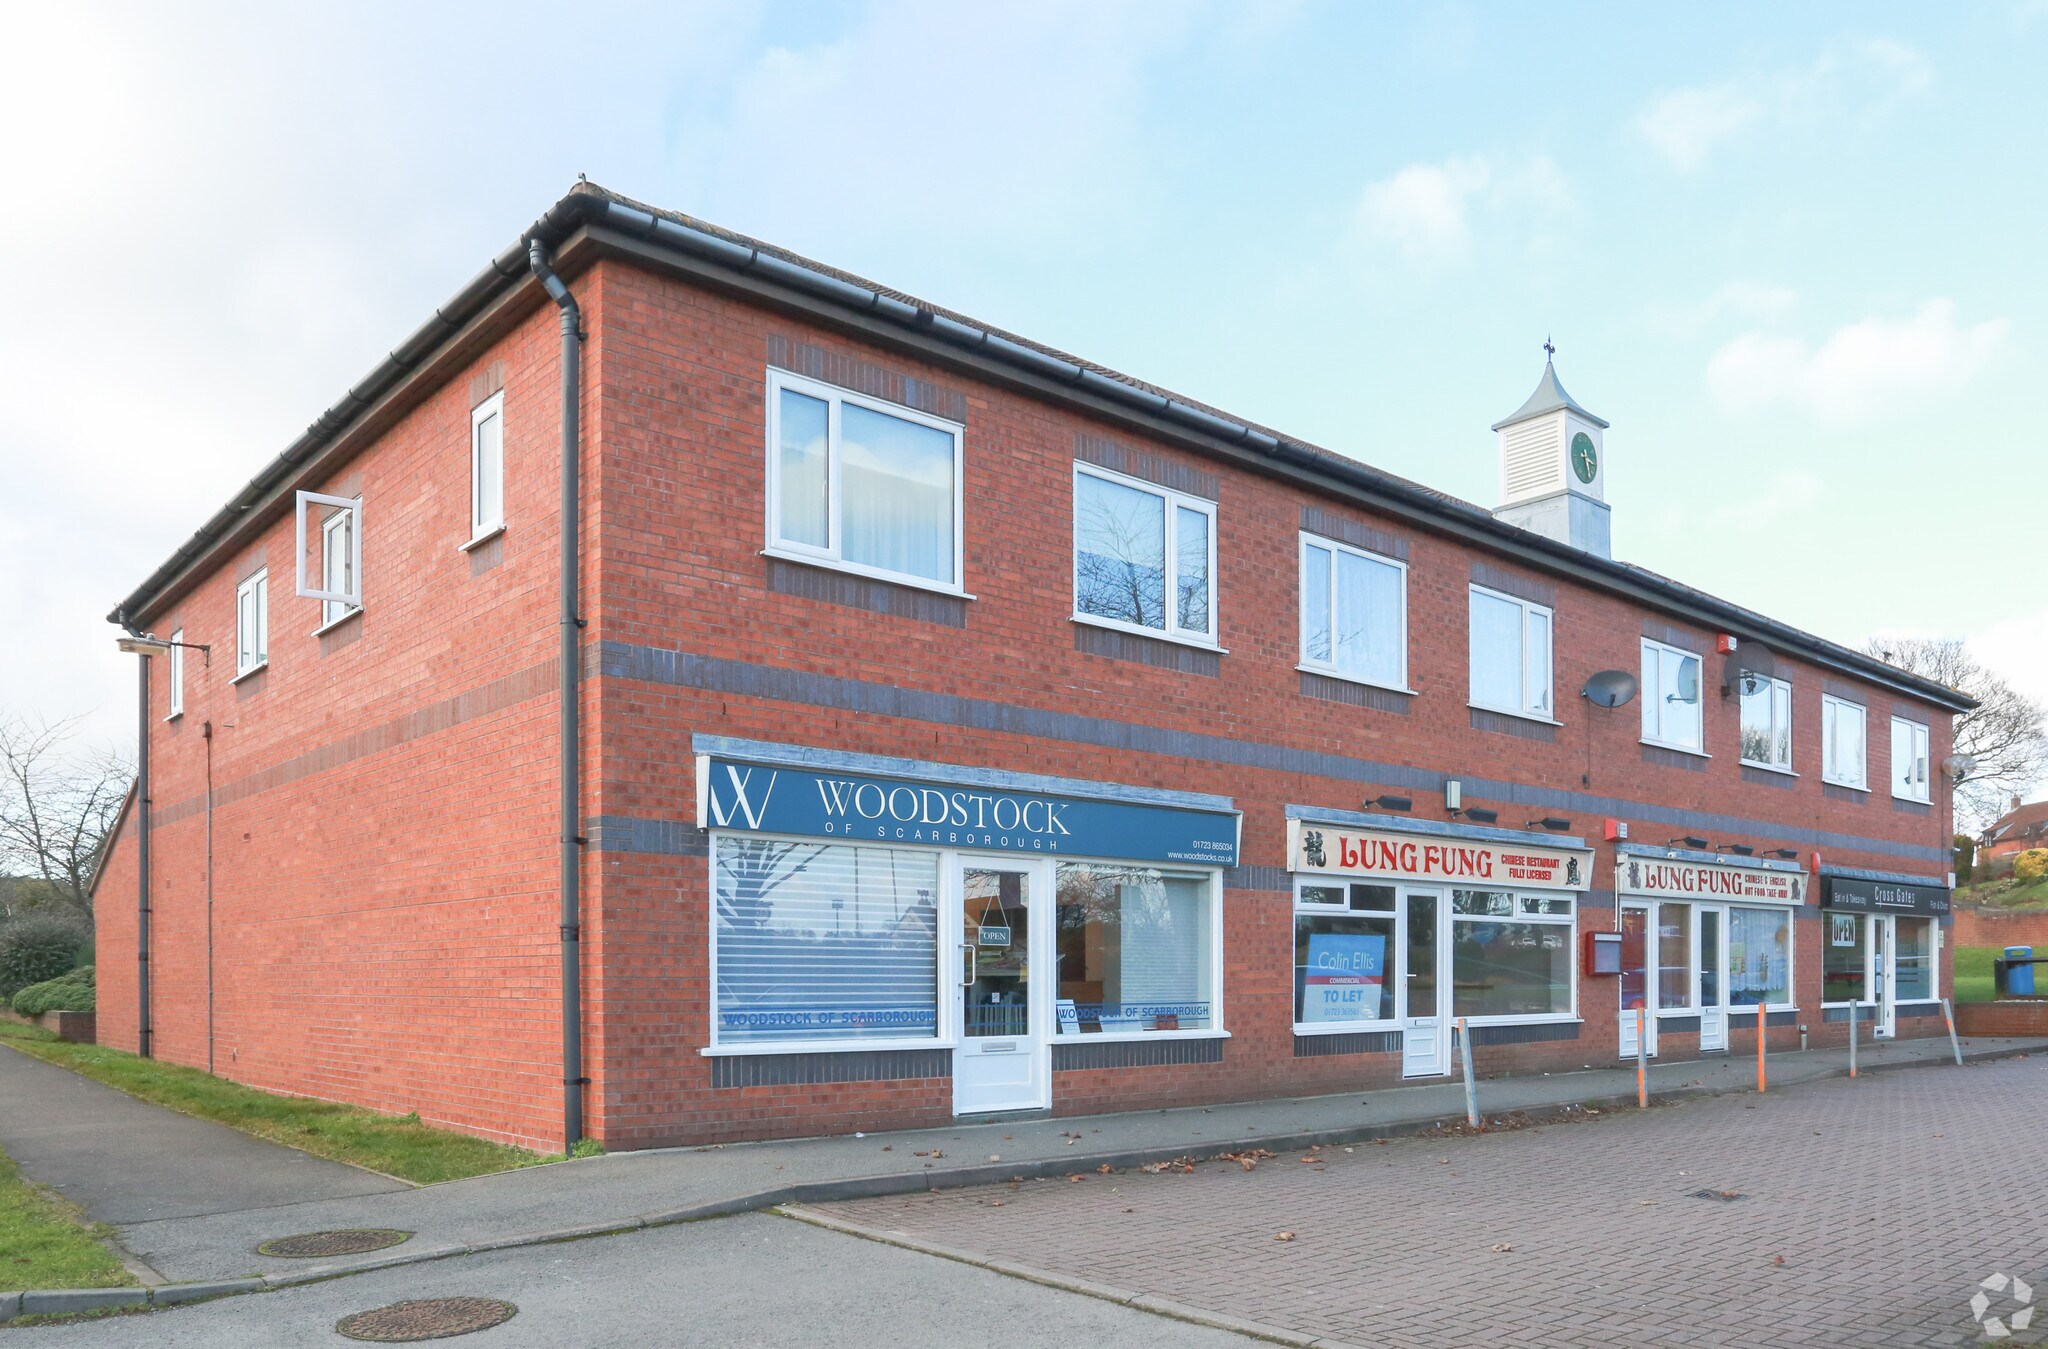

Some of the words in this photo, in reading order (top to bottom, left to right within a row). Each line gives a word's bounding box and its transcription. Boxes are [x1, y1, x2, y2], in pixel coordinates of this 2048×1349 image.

[815, 778, 1072, 835] WOODSTOCK
[825, 822, 852, 834] OF
[878, 827, 1057, 850] SCARBOROUGH
[1193, 840, 1211, 850] 01723
[1212, 842, 1233, 851] 865034
[1167, 851, 1233, 863] www.woodstocks.co.uk
[1339, 836, 1418, 873] LUNG
[1423, 845, 1492, 878] FUNG
[1501, 854, 1525, 866] CHINESE
[1527, 857, 1560, 869] RESTAURANT
[1509, 868, 1525, 878] FULLY
[1527, 869, 1552, 880] LICENSED
[1645, 864, 1694, 892] LUNG
[1698, 869, 1742, 895] FUNG
[1745, 874, 1763, 884] CHINESE
[1770, 877, 1787, 886] ENGLISH
[1745, 887, 1753, 896] HOT
[1875, 886, 1893, 906] Cross
[1896, 889, 1915, 904] Gates
[983, 932, 1006, 940] OPEN
[1834, 917, 1854, 941] OPEN
[1318, 952, 1350, 969] Colin
[1353, 952, 1375, 969] Ellis
[1324, 990, 1339, 1003] TO
[1342, 990, 1363, 1002] LET
[723, 1012, 812, 1025] WOODSTOCK
[818, 1012, 835, 1024] OF
[841, 1010, 935, 1023] SCARBOROUGH
[1058, 1008, 1121, 1018] WOODSTOCK
[1126, 1007, 1138, 1017] OF
[1142, 1006, 1209, 1016] SCARBOROUGH
